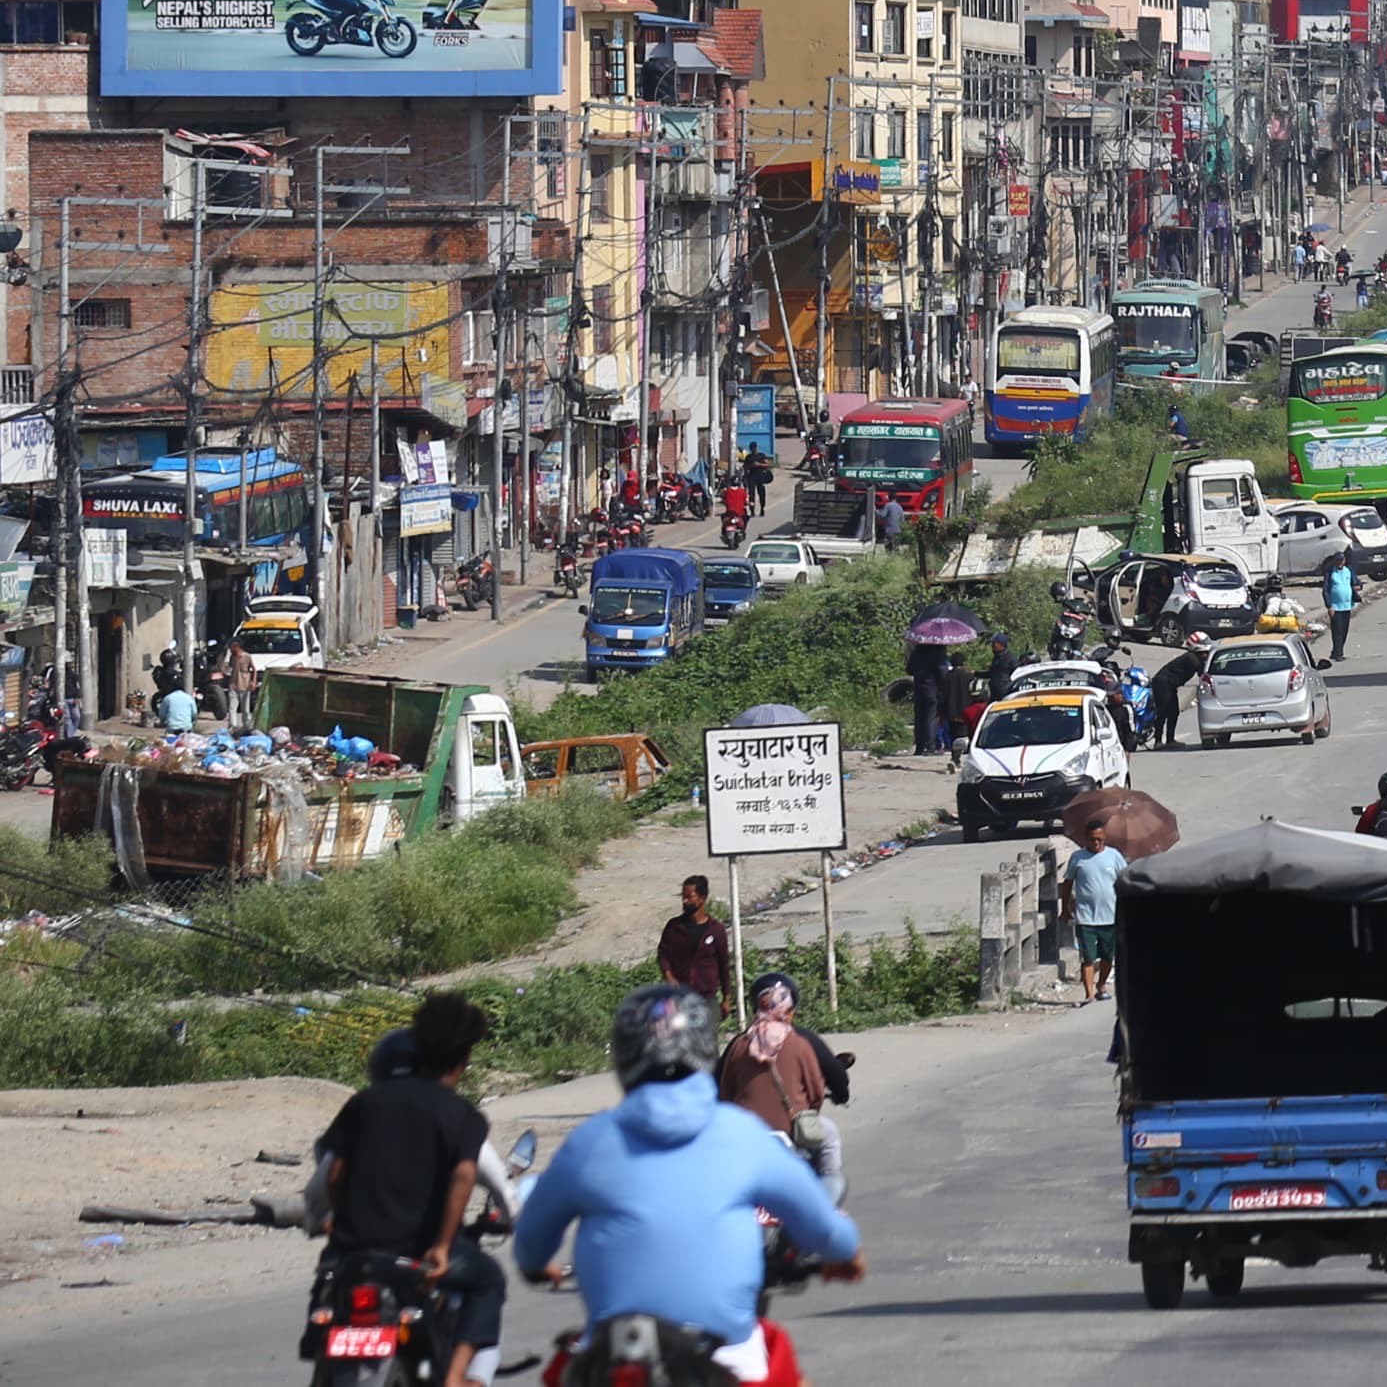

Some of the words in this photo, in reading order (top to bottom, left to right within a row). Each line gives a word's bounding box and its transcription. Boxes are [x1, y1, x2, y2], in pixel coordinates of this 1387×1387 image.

[157, 0, 213, 16] NEPAL'S
[216, 0, 273, 16] HIGHEST
[157, 16, 200, 29] SELLING
[202, 16, 273, 29] MOTORCYCLE
[434, 37, 469, 46] FORKS
[1117, 305, 1192, 318] RAJTHALA
[92, 499, 140, 512] SHUVA
[797, 733, 829, 765] पुल
[713, 771, 783, 792] Suichatar
[788, 769, 833, 792] Bridge
